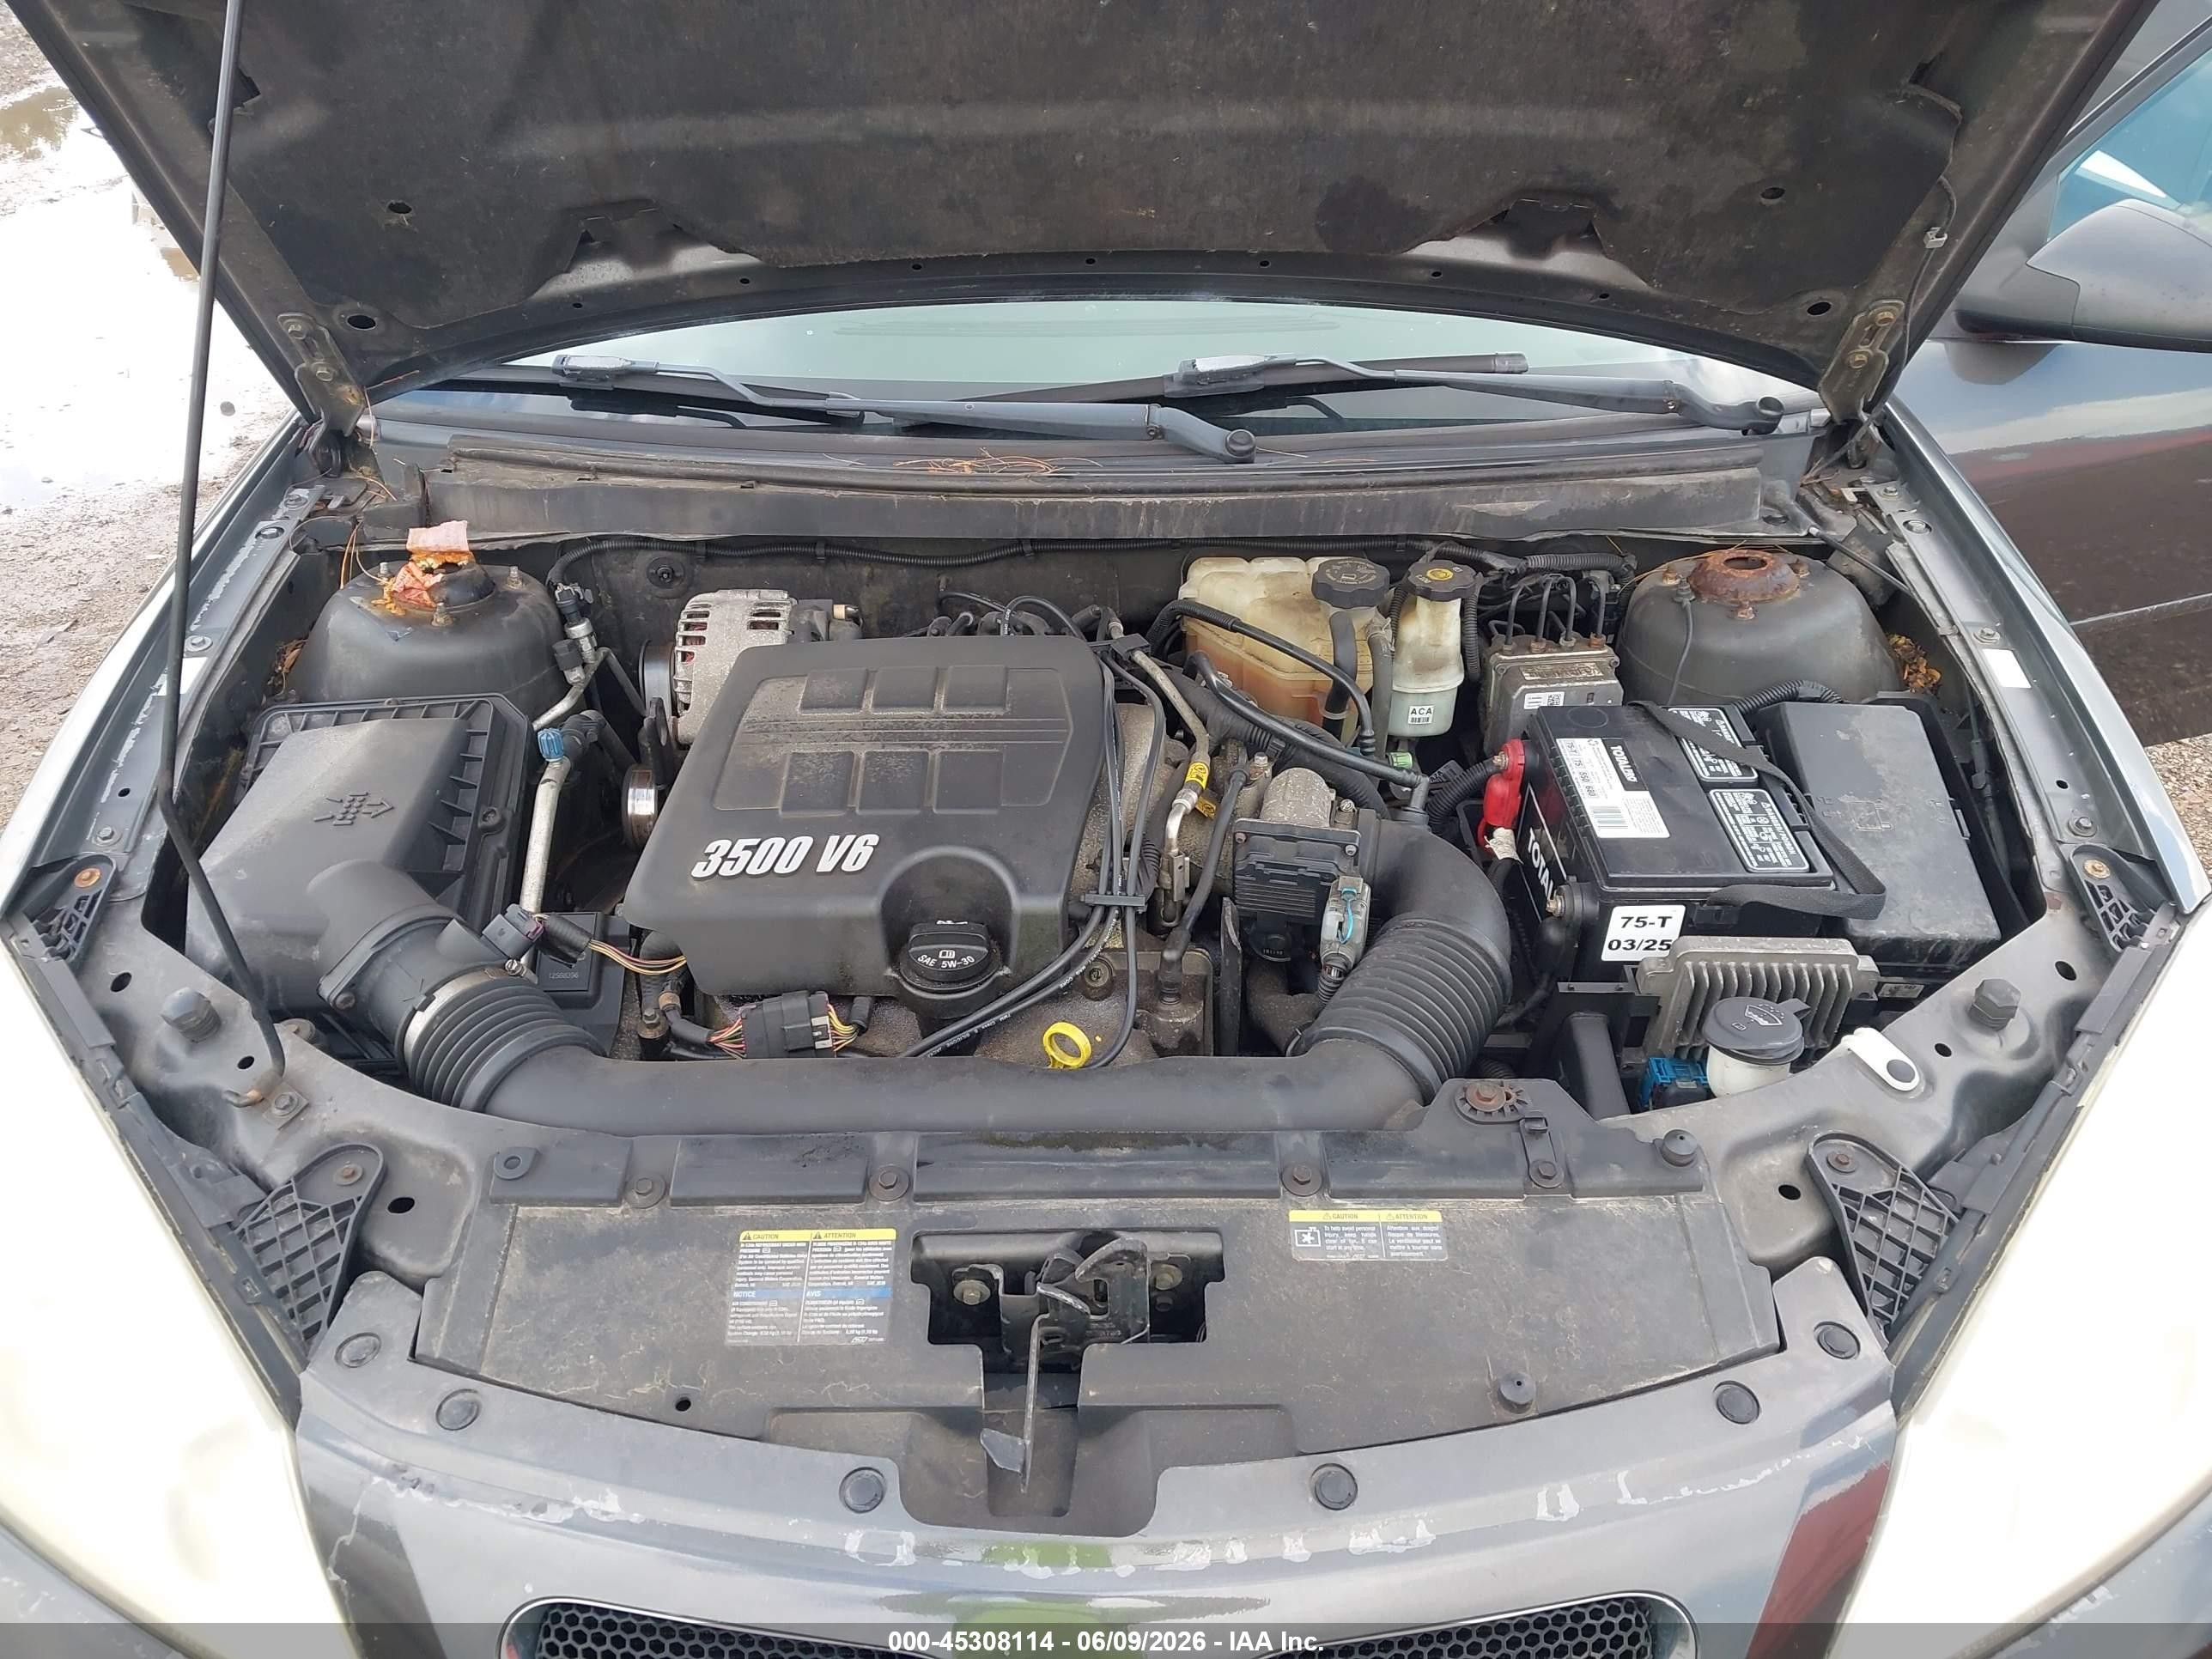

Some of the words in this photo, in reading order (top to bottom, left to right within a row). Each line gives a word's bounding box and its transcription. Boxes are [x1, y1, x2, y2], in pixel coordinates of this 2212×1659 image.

[1410, 707, 1432, 715] ACA
[690, 836, 814, 878] 3500
[816, 834, 880, 873] V6
[1620, 915, 1673, 929] 75-T
[1607, 938, 1671, 951] 03/25
[917, 954, 938, 967] SAE
[940, 956, 975, 969] 5W-30
